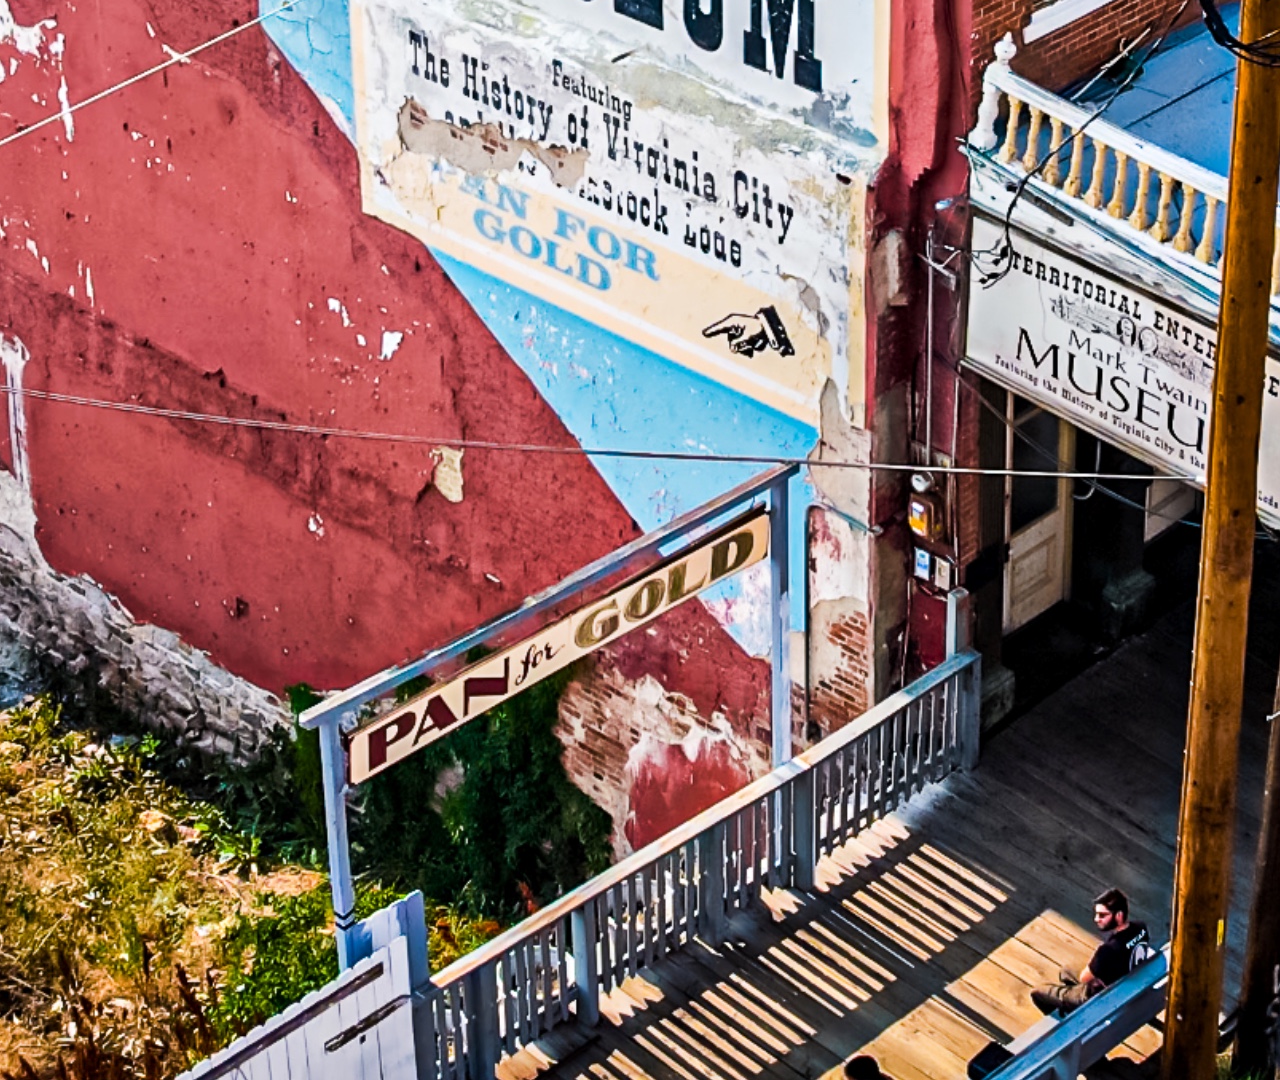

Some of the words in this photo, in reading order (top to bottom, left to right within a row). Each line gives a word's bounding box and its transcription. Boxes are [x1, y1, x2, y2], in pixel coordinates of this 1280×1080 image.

[551, 58, 634, 121] Featuring
[408, 29, 451, 88] The
[462, 53, 554, 141] History
[568, 105, 590, 149] of
[602, 112, 718, 204] Virginia
[733, 170, 794, 244] City
[472, 207, 613, 292] GOLD
[554, 207, 662, 282] FOR
[1009, 251, 1143, 320] TERRITORIAL
[995, 354, 1039, 387] Featuring
[1042, 377, 1058, 395] the
[1062, 386, 1096, 414] History
[1098, 407, 1109, 421] of
[1111, 413, 1152, 444] Virginia
[1153, 437, 1176, 456] City
[1016, 326, 1205, 455] MUSEU
[1068, 329, 1127, 375] Mark
[1137, 362, 1209, 416] Twain
[367, 656, 511, 772] PAN
[515, 640, 565, 687] for
[574, 528, 755, 649] GOLD
